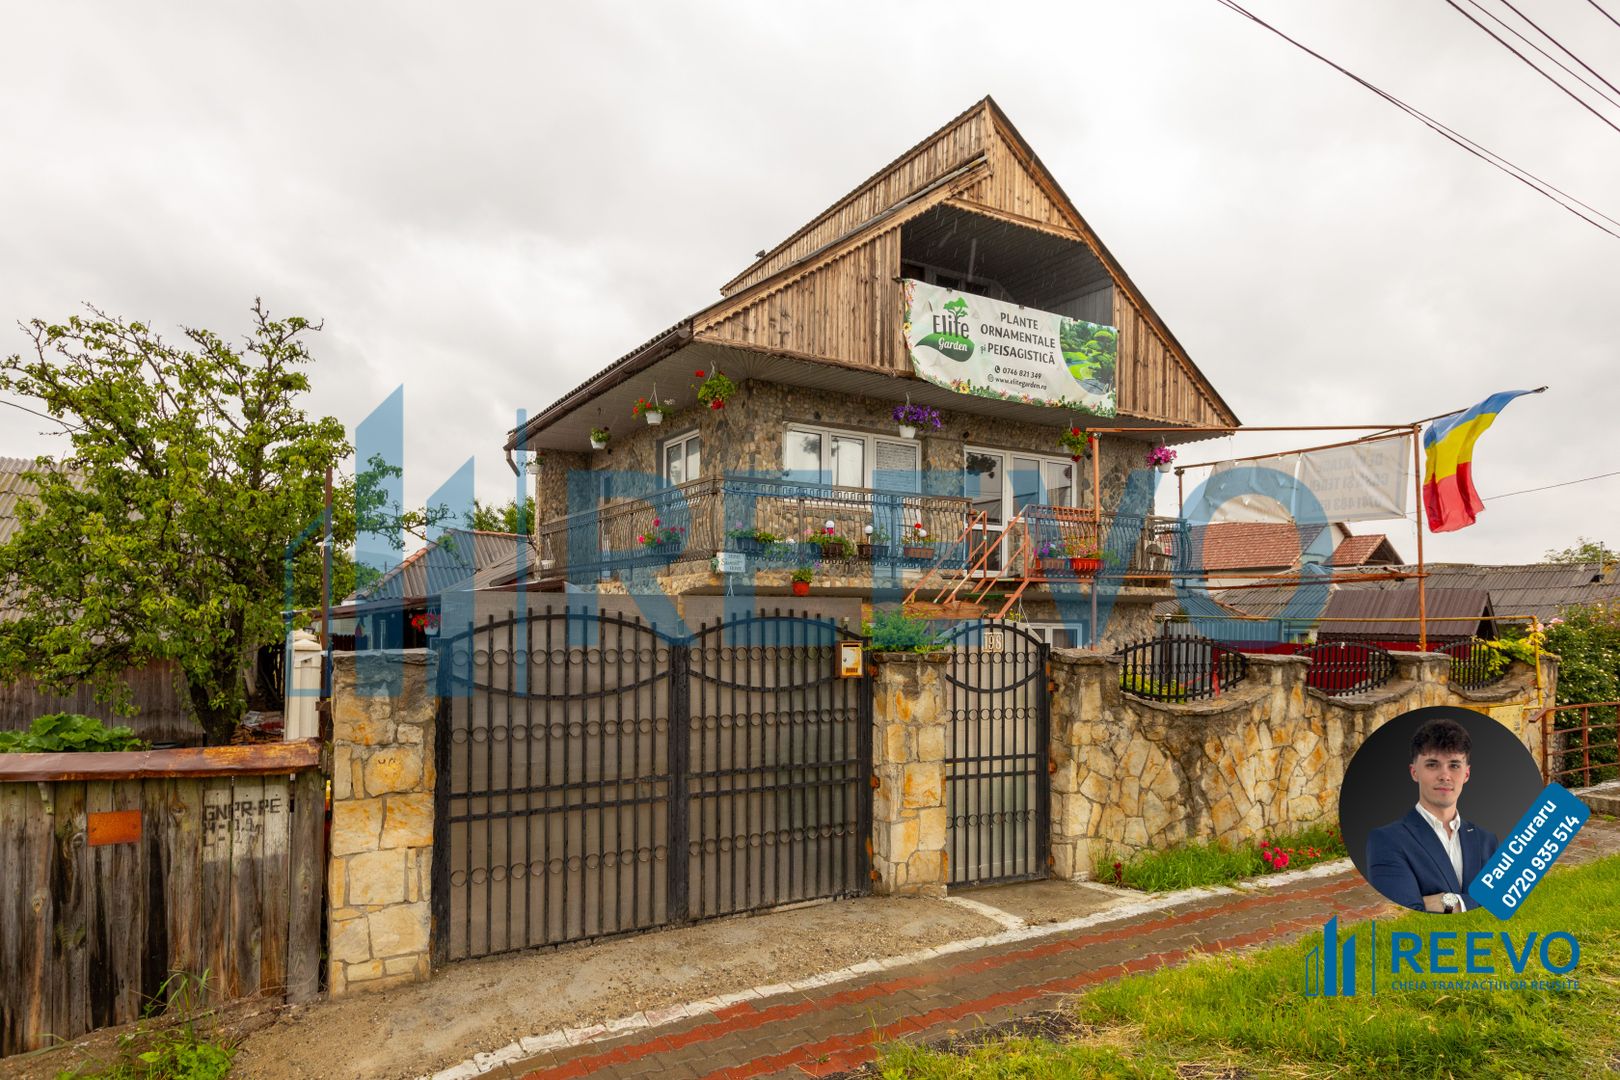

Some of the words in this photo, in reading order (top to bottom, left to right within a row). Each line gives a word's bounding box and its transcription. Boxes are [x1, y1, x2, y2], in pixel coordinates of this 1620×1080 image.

[1000, 312, 1038, 330] PLANTE
[938, 337, 968, 351] Garden
[980, 323, 1056, 349] ORNAMENTALE
[987, 342, 1055, 365] PEISAGISTICĂ
[1002, 367, 1018, 376] 0746
[1019, 369, 1030, 378] 821
[1030, 371, 1042, 380] 349
[984, 634, 1002, 650] 198
